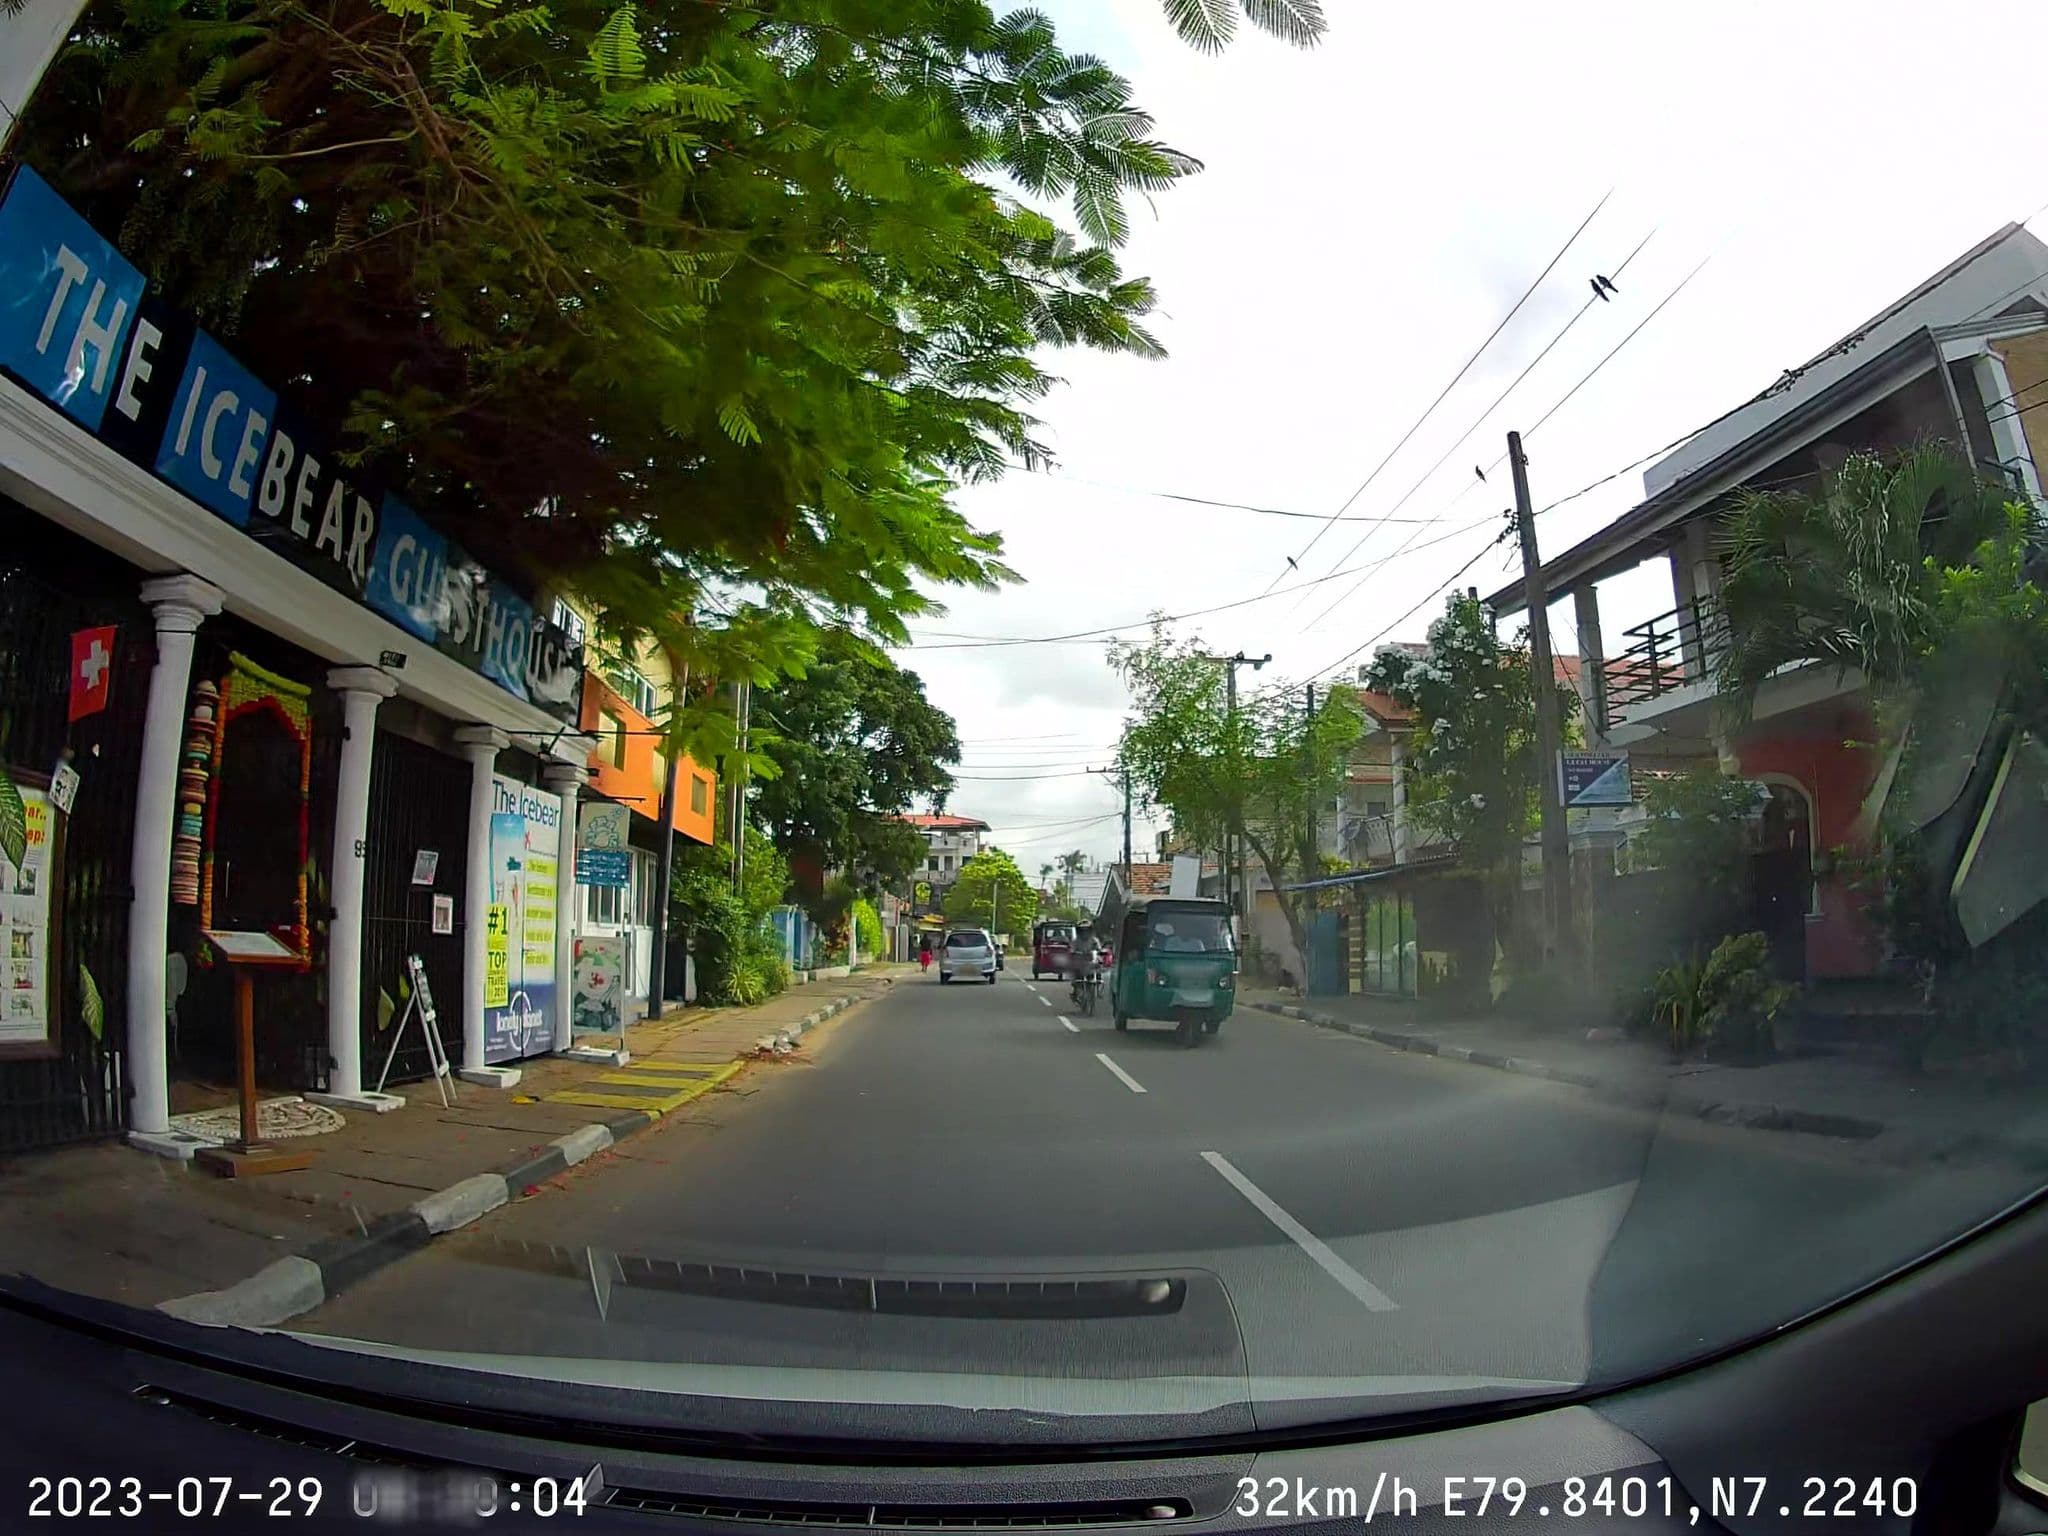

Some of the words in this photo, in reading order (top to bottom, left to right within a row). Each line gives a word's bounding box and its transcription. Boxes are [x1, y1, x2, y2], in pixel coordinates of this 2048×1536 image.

[35, 243, 163, 422] THE
[174, 366, 376, 582] ICEBEAR
[492, 779, 516, 815] The
[518, 788, 560, 828] Icebear
[487, 906, 508, 936] #1
[487, 951, 508, 969] TOP
